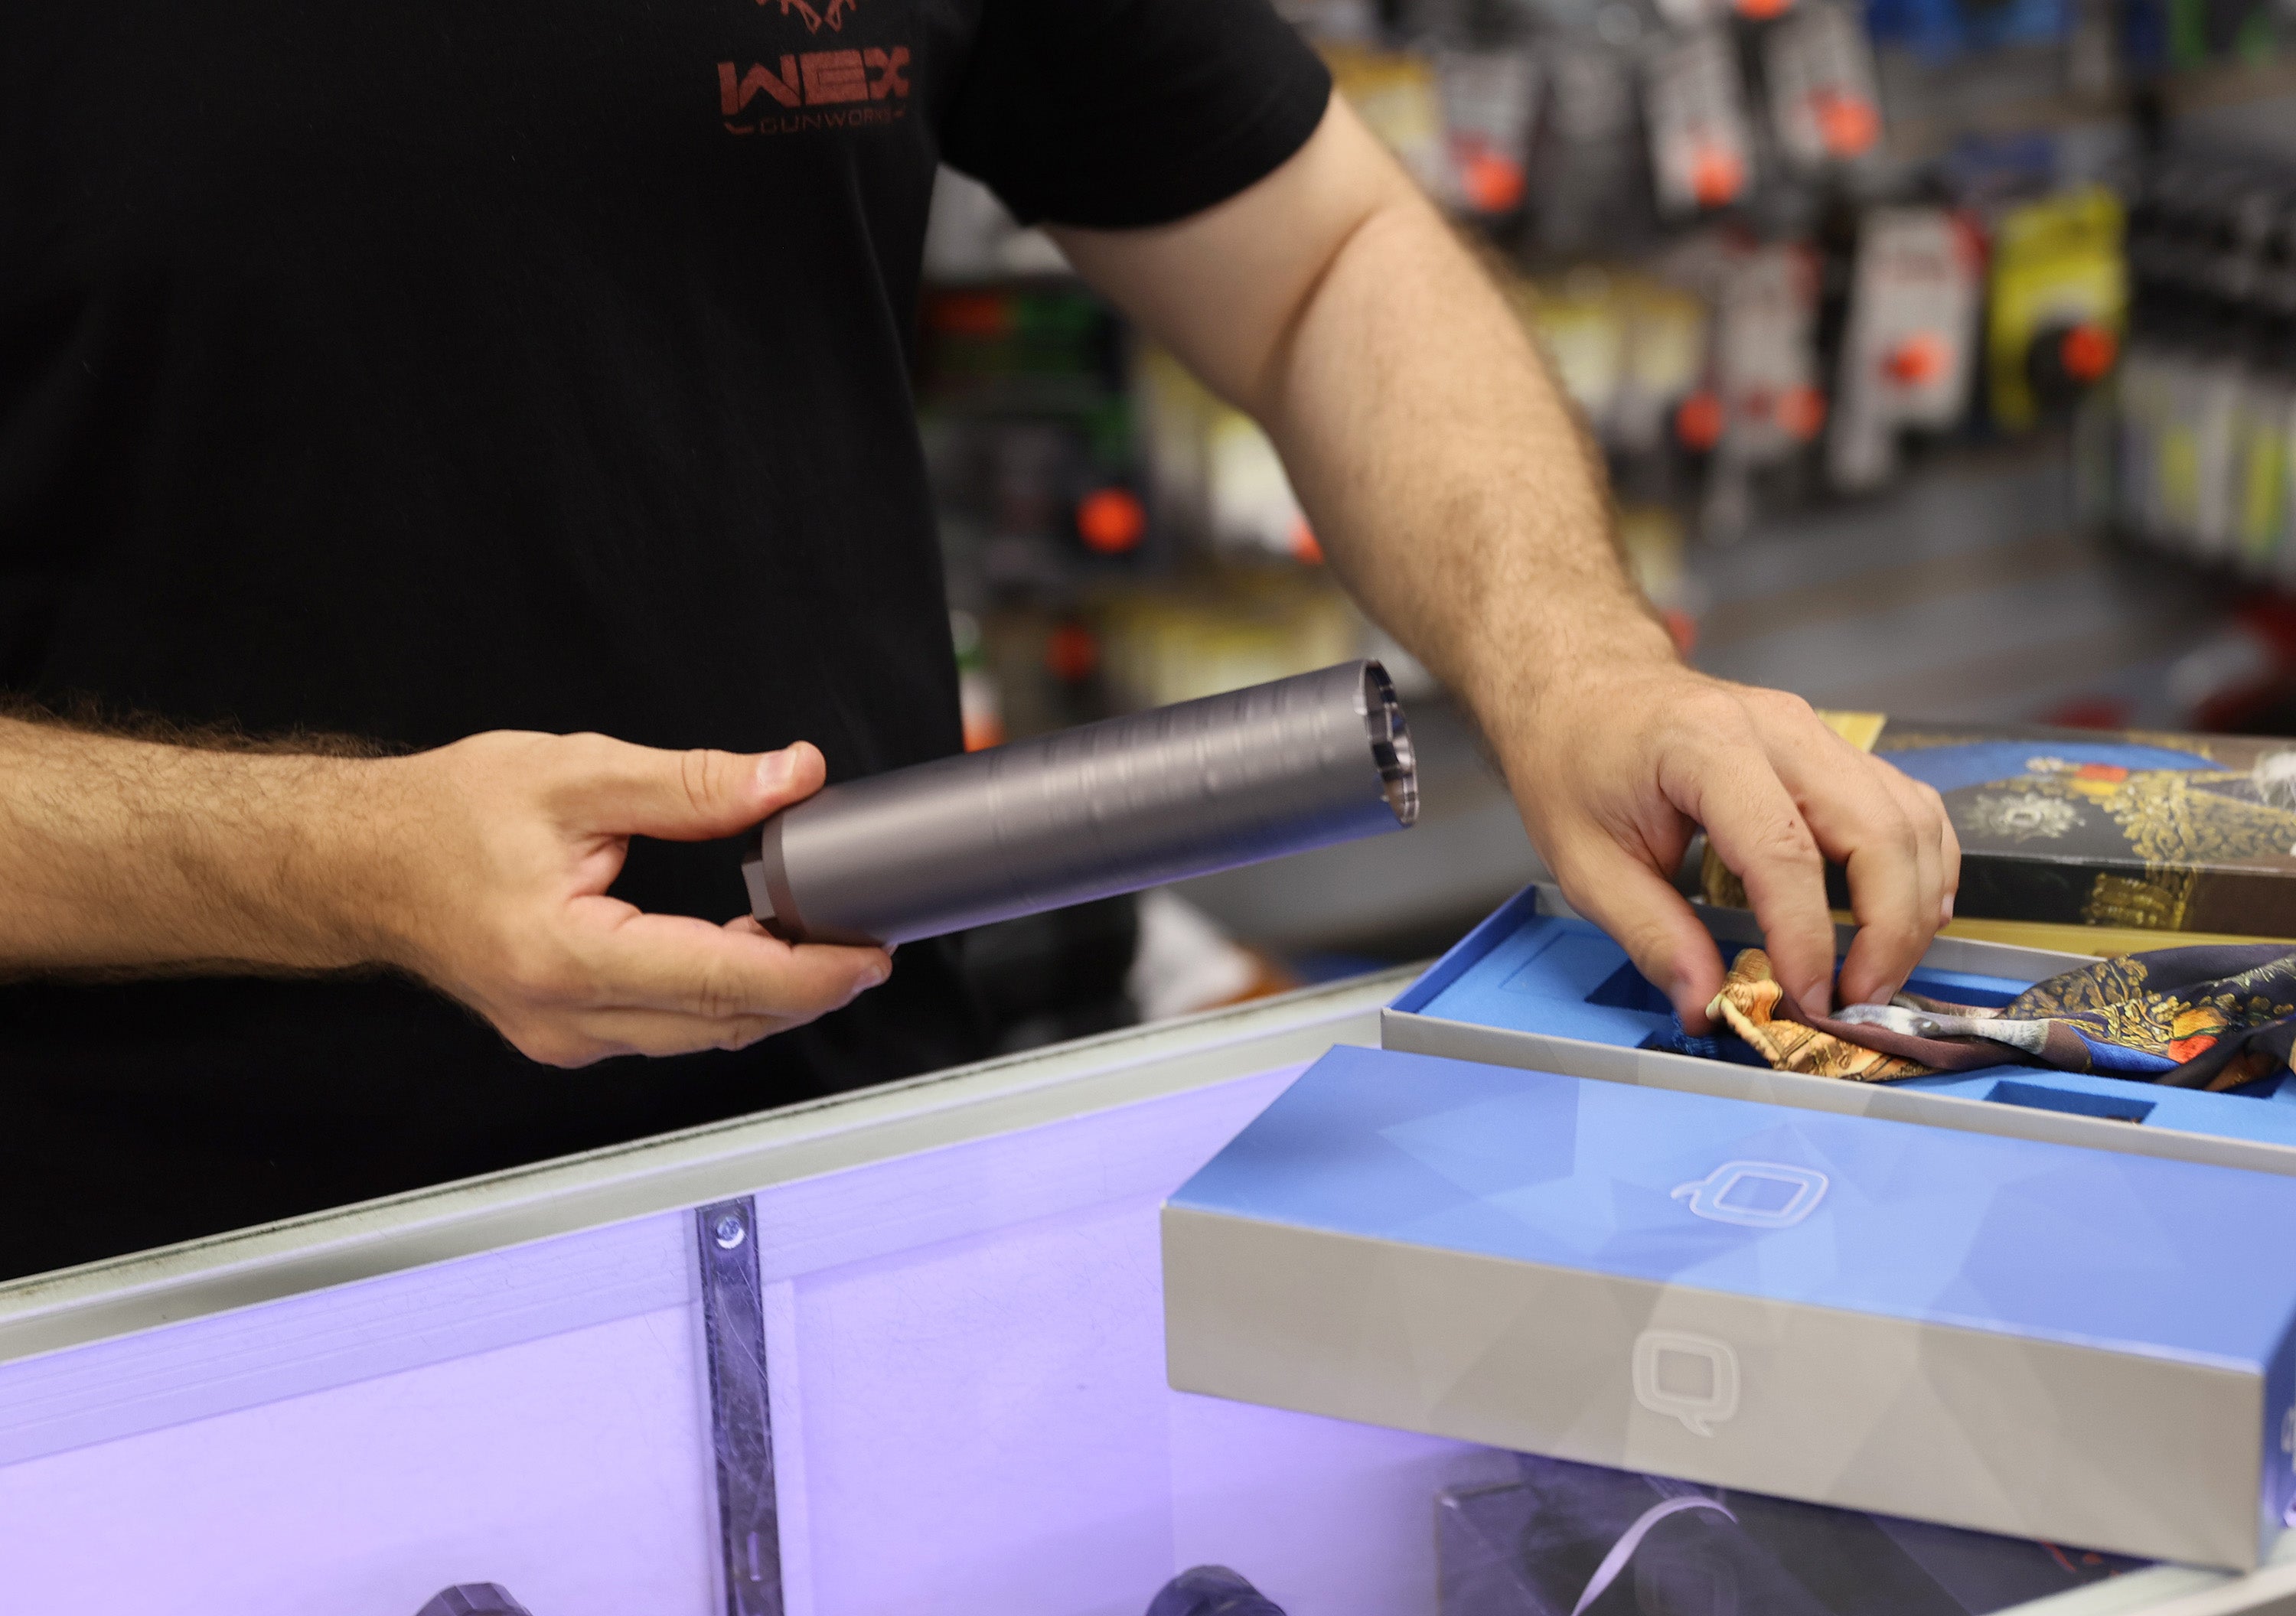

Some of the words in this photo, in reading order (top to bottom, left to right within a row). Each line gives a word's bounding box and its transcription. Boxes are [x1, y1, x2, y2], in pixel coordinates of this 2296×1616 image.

[717, 44, 911, 116] WEX
[1670, 1160, 1830, 1230] Q
[1632, 1329, 1741, 1438] Q
